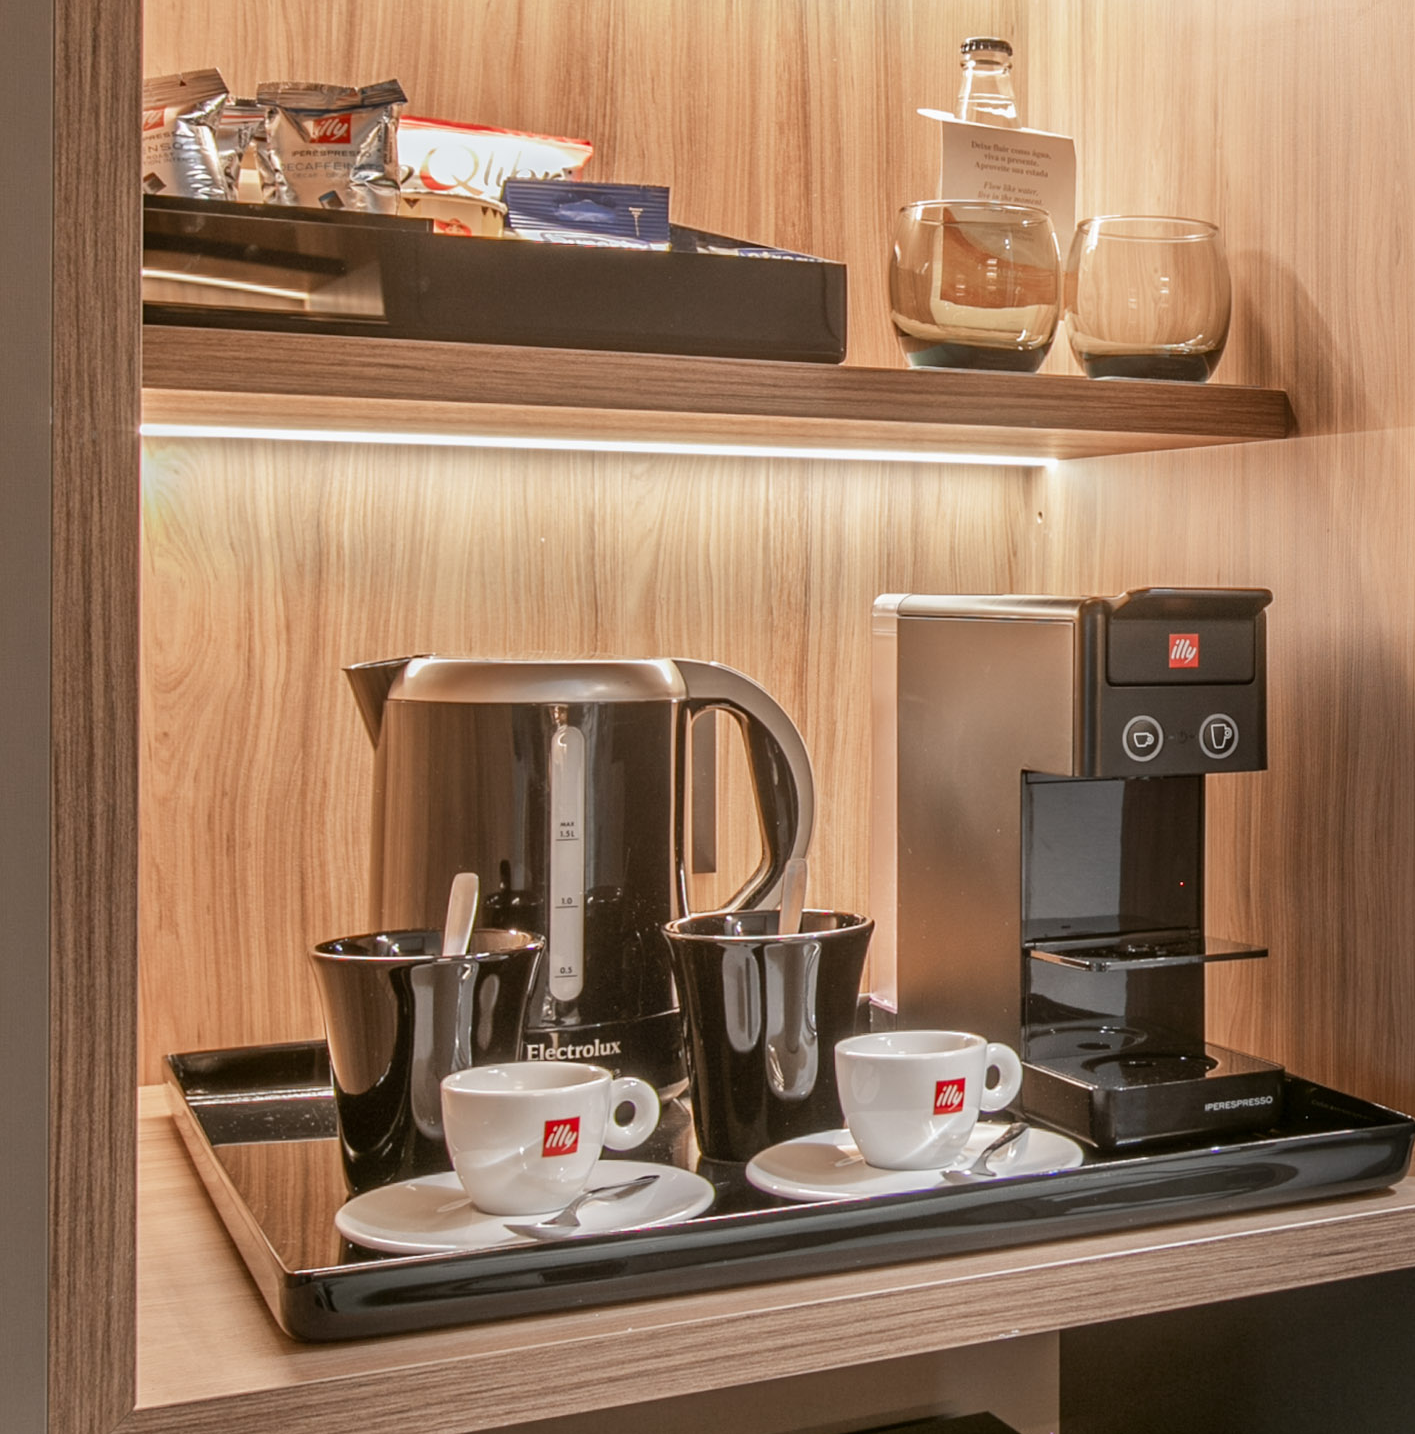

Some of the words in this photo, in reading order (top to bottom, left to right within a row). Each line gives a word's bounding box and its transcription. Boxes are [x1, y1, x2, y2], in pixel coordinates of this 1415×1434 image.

[319, 118, 349, 141] illy
[984, 153, 999, 162] viva
[1171, 639, 1197, 664] illy
[561, 897, 573, 905] 1.0
[560, 967, 573, 975] 0.5
[527, 1038, 622, 1061] Electrolux
[936, 1084, 964, 1111] illy
[1204, 1095, 1274, 1112] IPERESPRESSO
[545, 1124, 578, 1152] illy
